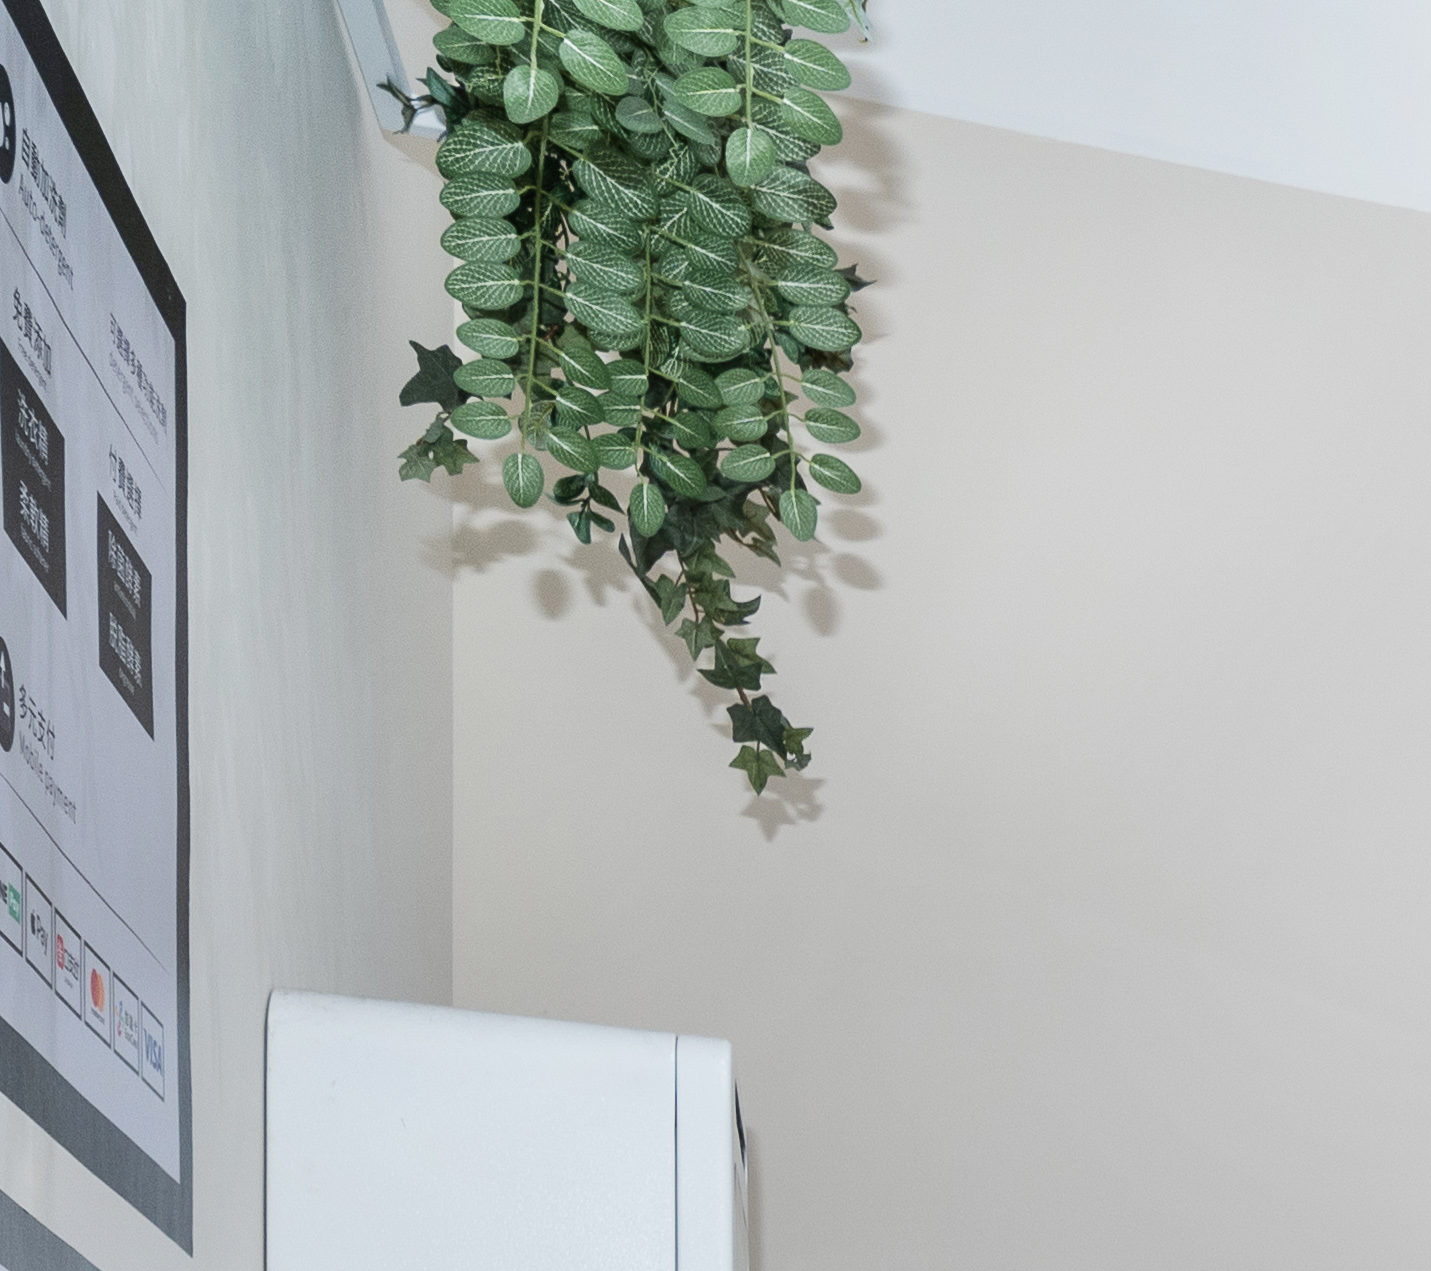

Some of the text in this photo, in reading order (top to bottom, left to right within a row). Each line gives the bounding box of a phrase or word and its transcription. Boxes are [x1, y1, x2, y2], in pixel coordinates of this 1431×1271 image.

[19, 683, 55, 761] 多元支付
[18, 728, 76, 824] Mobile payment
[36, 912, 48, 956] Pay
[143, 1027, 163, 1076] VISA
